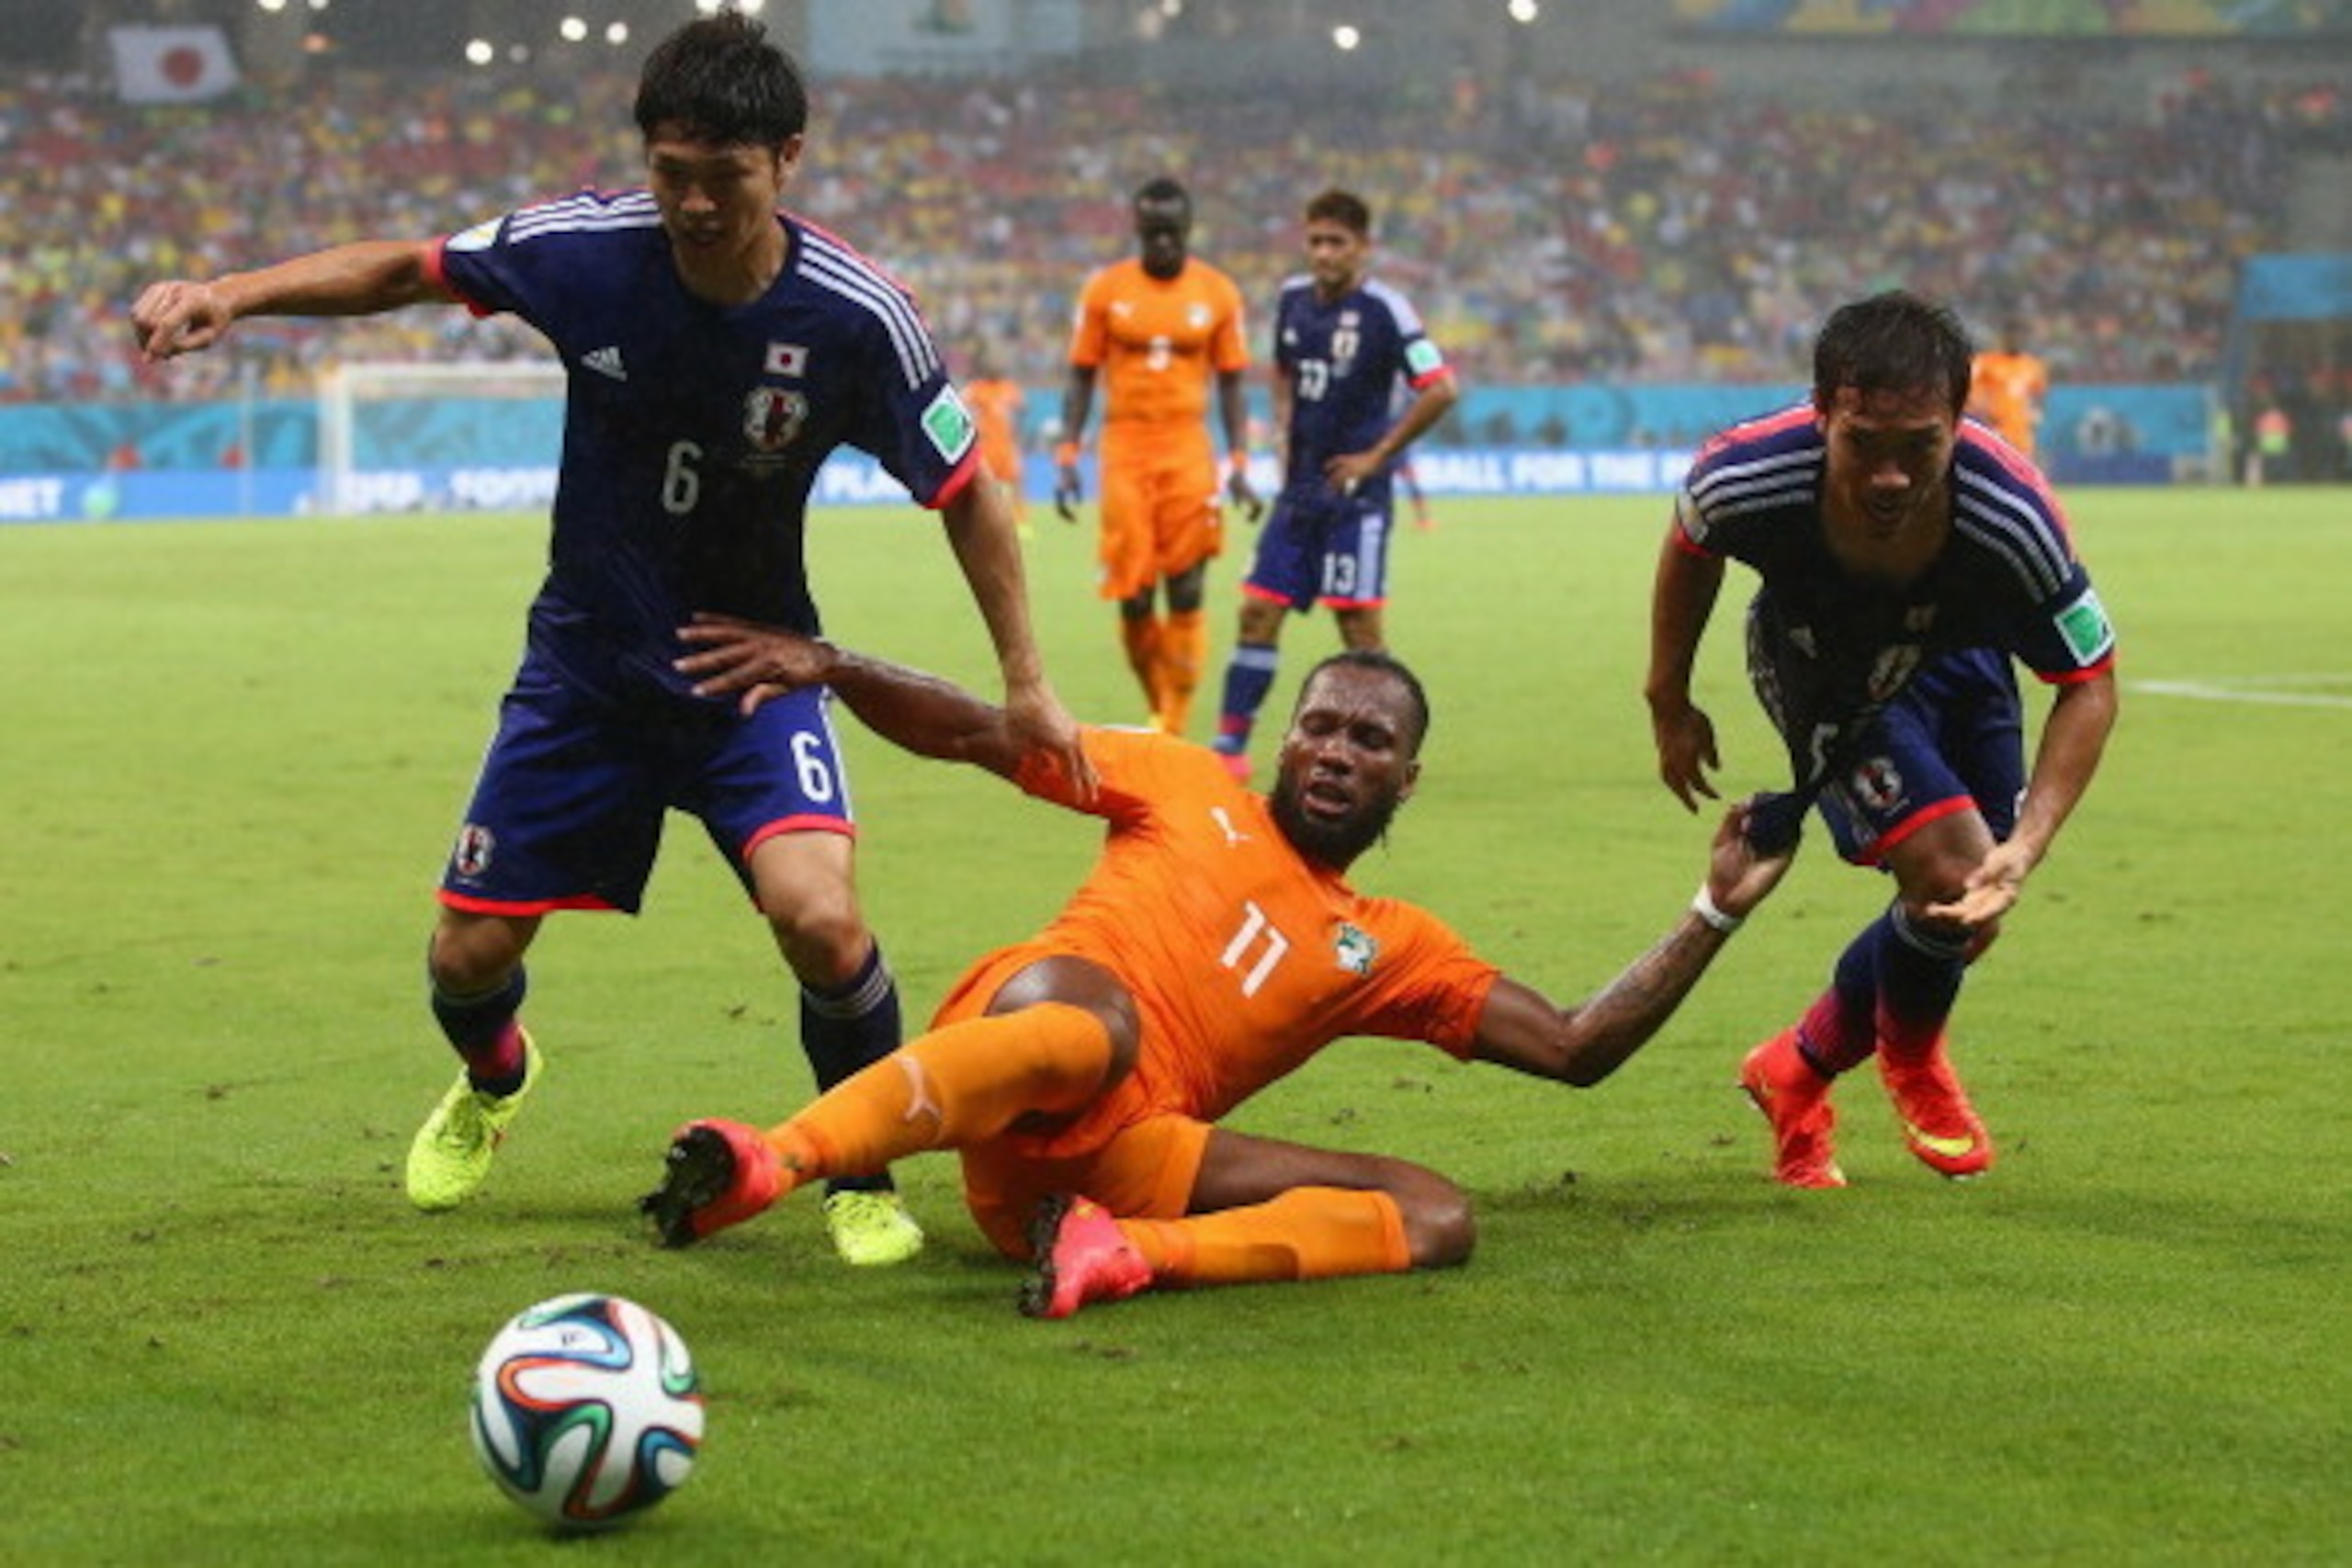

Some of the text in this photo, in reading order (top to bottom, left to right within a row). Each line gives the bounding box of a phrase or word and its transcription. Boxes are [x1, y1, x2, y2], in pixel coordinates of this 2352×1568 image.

[662, 439, 704, 515] 6
[1320, 551, 1357, 596] 13
[790, 730, 833, 803] 6
[1220, 899, 1289, 999] 11
